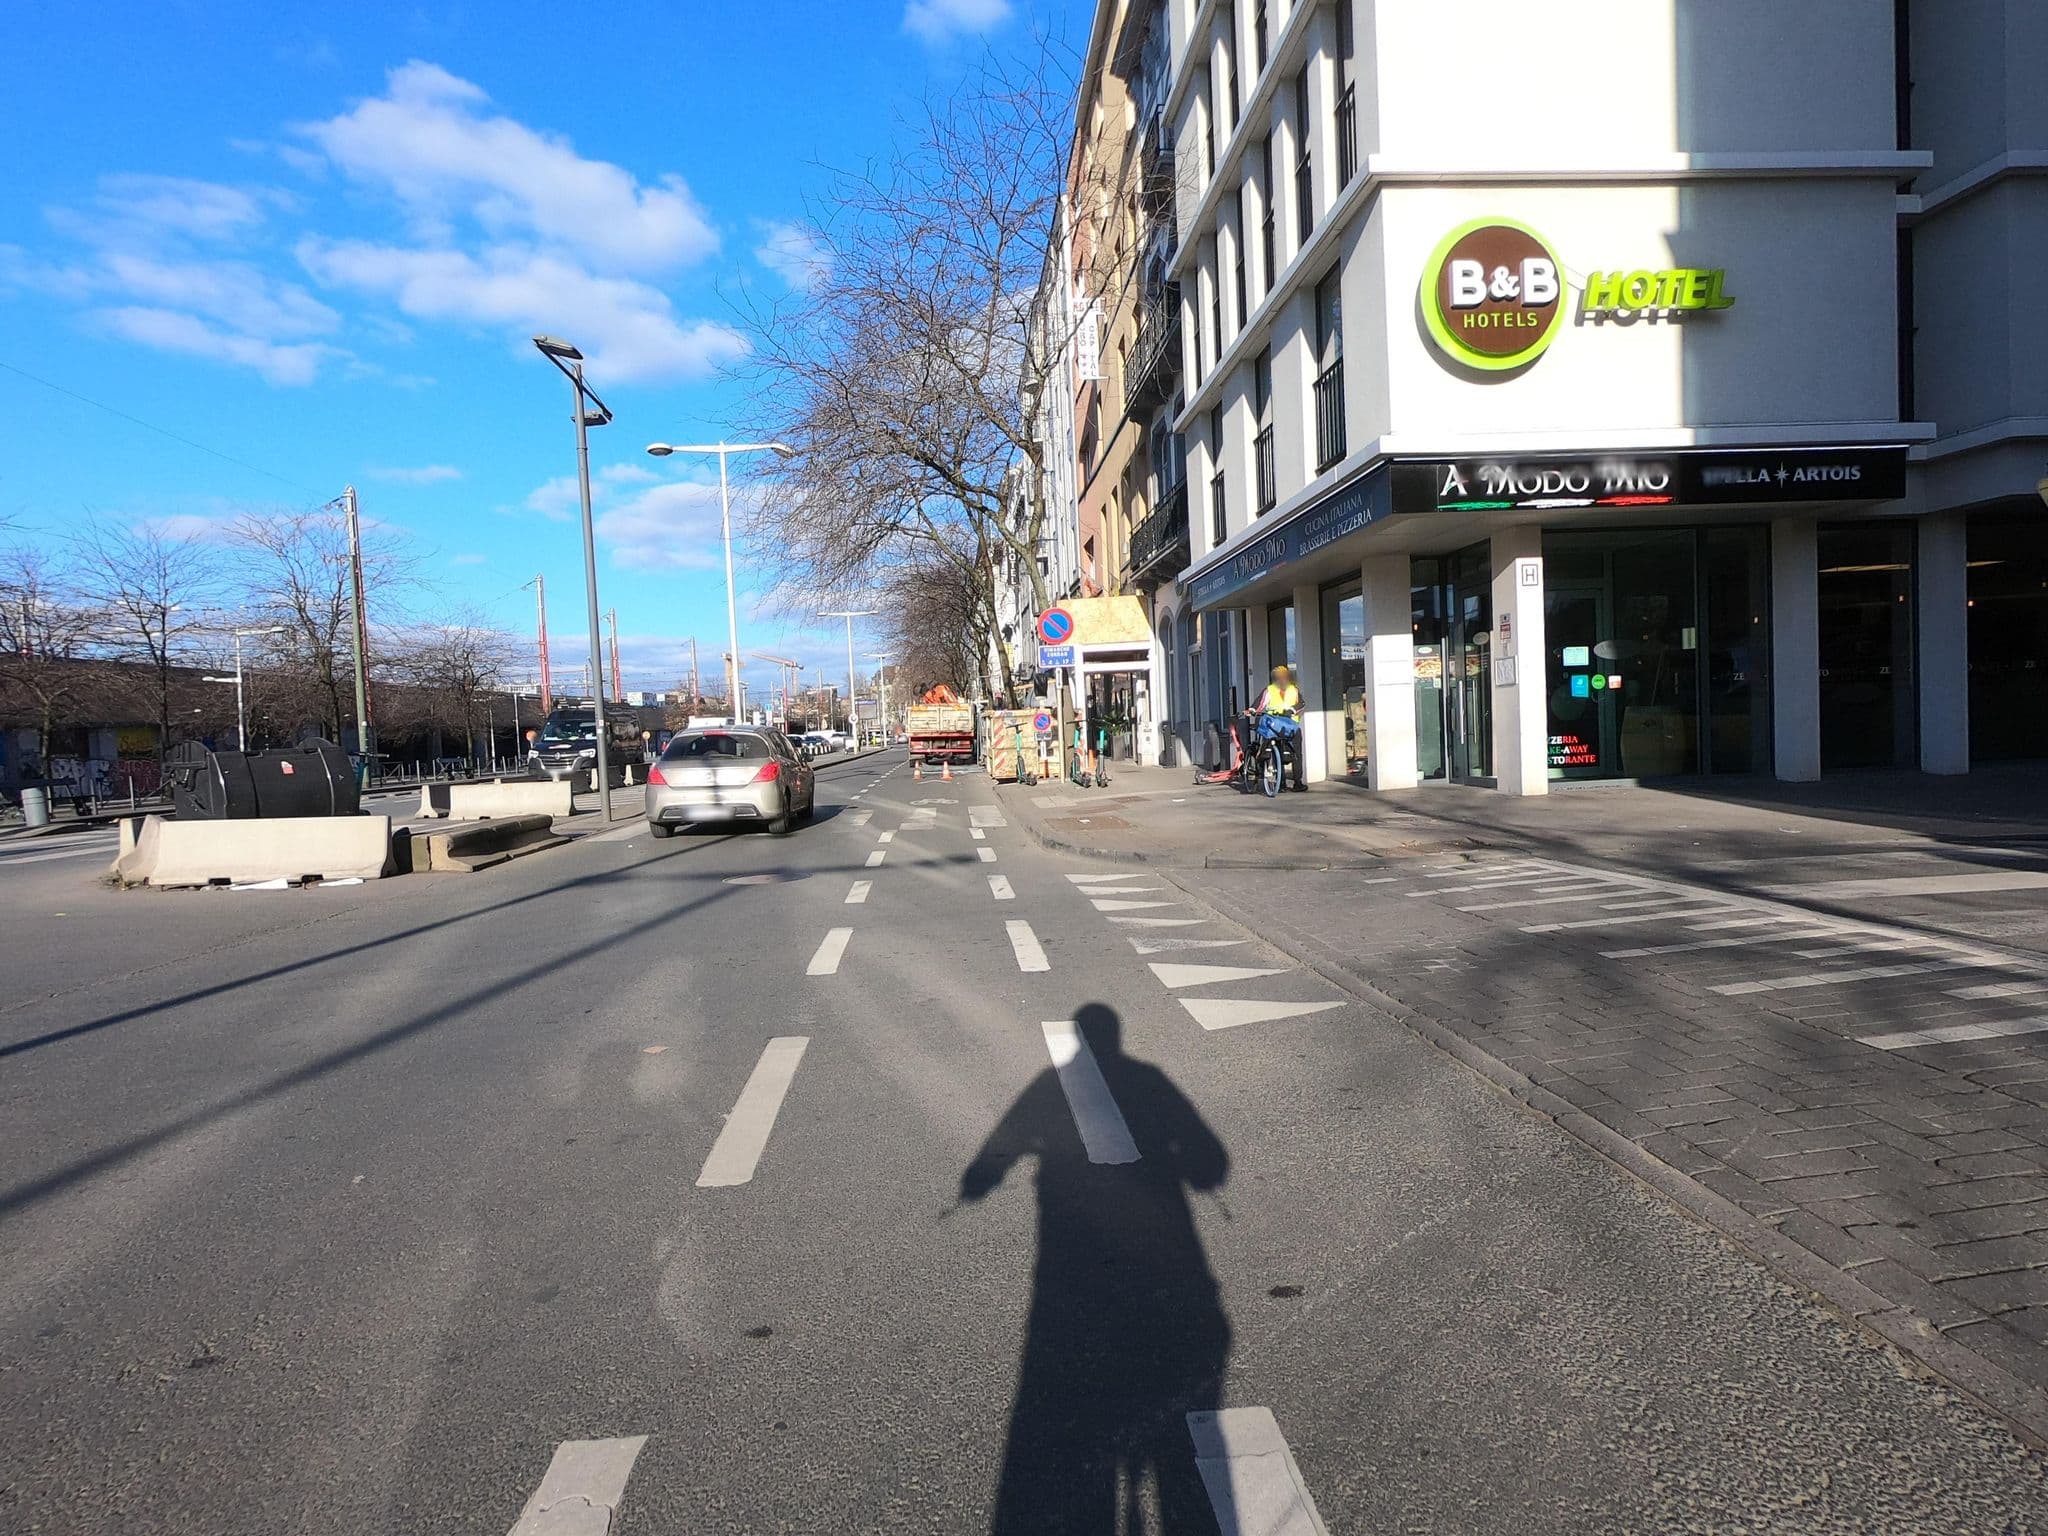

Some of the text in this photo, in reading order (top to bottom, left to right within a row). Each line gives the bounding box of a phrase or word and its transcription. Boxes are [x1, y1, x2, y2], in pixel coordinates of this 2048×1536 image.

[1449, 257, 1560, 309] B&B
[1582, 269, 1737, 312] HOTEL
[1463, 312, 1538, 329] HOTELS
[1440, 464, 1468, 496] A
[1793, 465, 1862, 482] ARTOIS
[1330, 493, 1363, 523] ITALIANA
[1337, 508, 1372, 537] PIZZERIA
